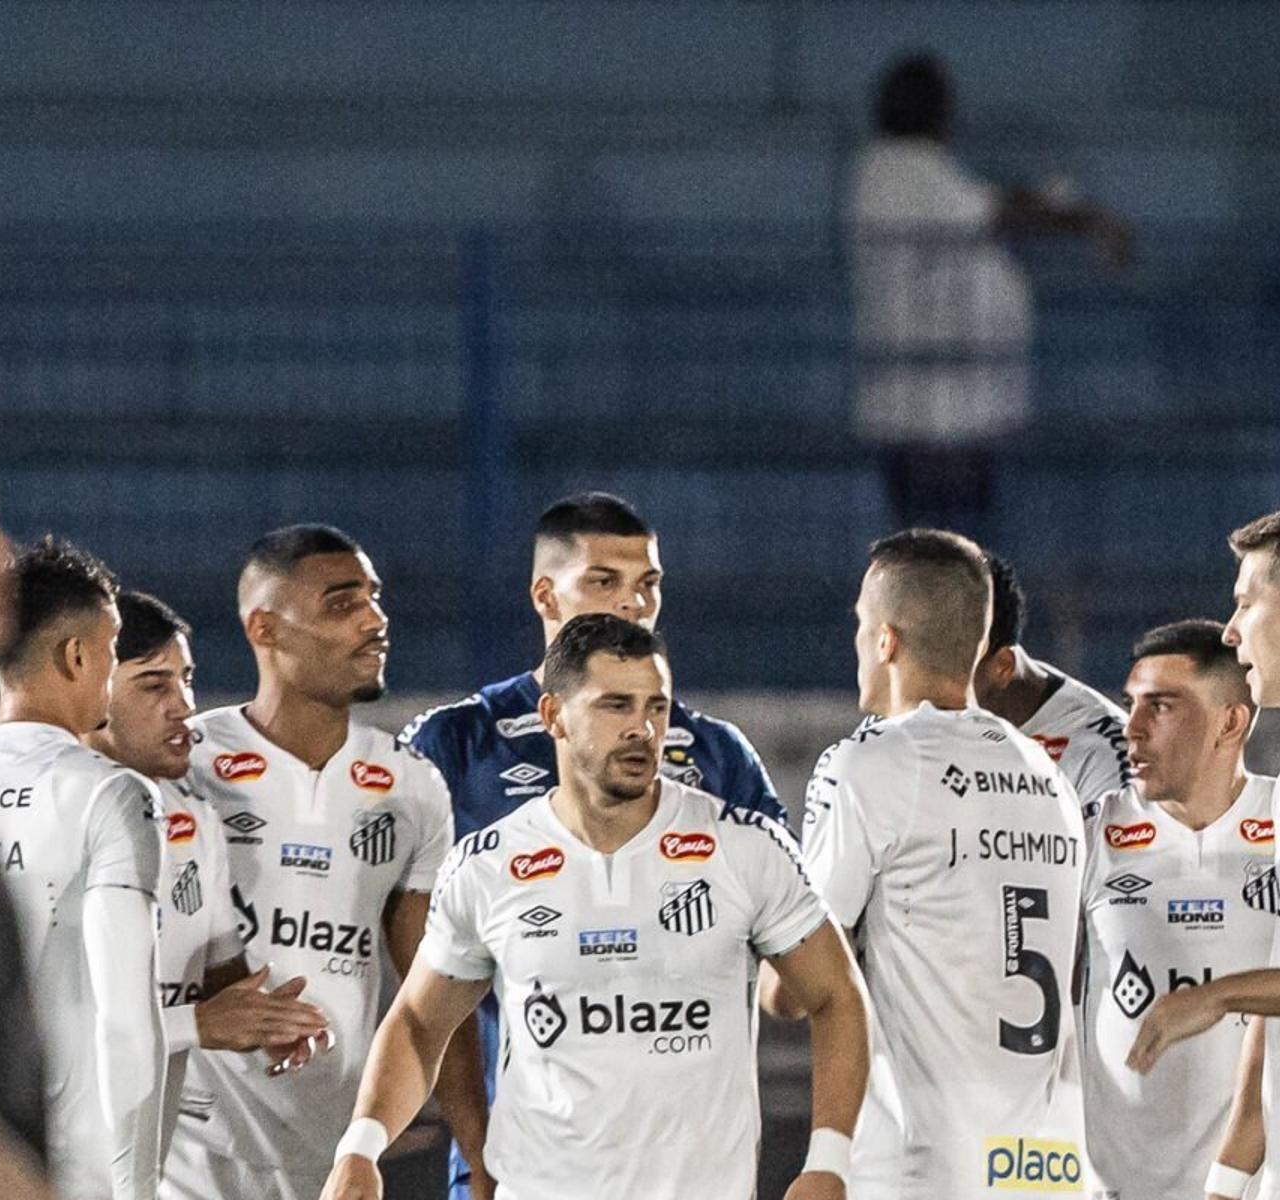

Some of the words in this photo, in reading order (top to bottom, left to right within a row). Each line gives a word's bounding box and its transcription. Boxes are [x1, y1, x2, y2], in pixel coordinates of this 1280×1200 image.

[974, 771, 1058, 798] BINANC
[949, 828, 968, 868] J.
[979, 829, 1079, 867] SCHMIDT
[271, 907, 372, 958] blaze
[1168, 912, 1224, 923] BOND
[580, 943, 637, 956] BOND
[999, 885, 1062, 1055] 5
[579, 994, 711, 1035] blaze
[648, 1033, 712, 1054] .com
[987, 1138, 1081, 1187] placo
